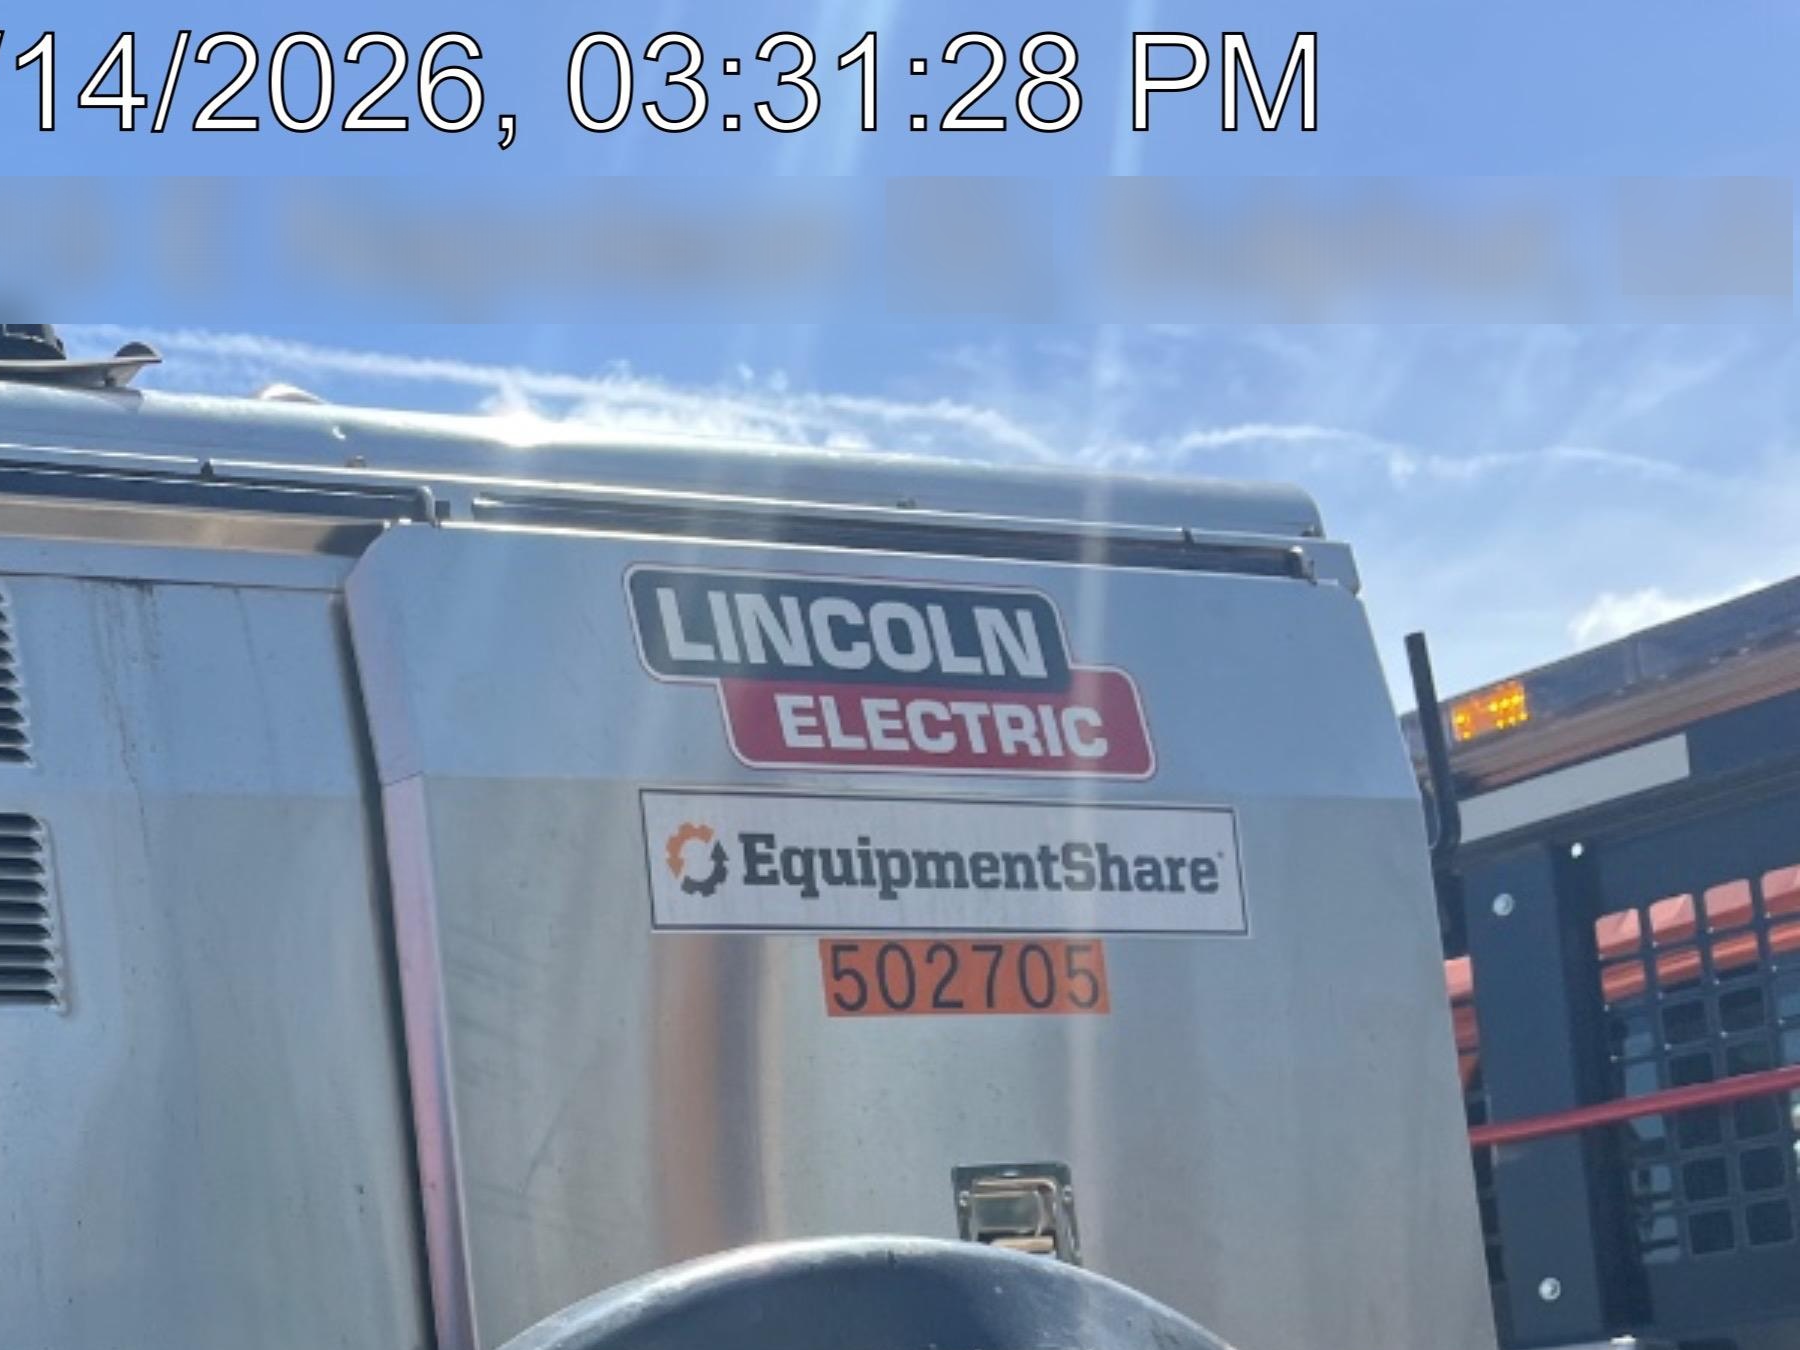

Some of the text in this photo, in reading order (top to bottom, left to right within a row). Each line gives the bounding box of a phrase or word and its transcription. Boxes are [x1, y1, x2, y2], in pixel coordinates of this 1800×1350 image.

[656, 588, 1048, 678] LINCOLN
[775, 694, 1108, 758] ELECTRIC
[738, 832, 1219, 900] EquipmentShare
[830, 943, 1100, 1012] 502705
